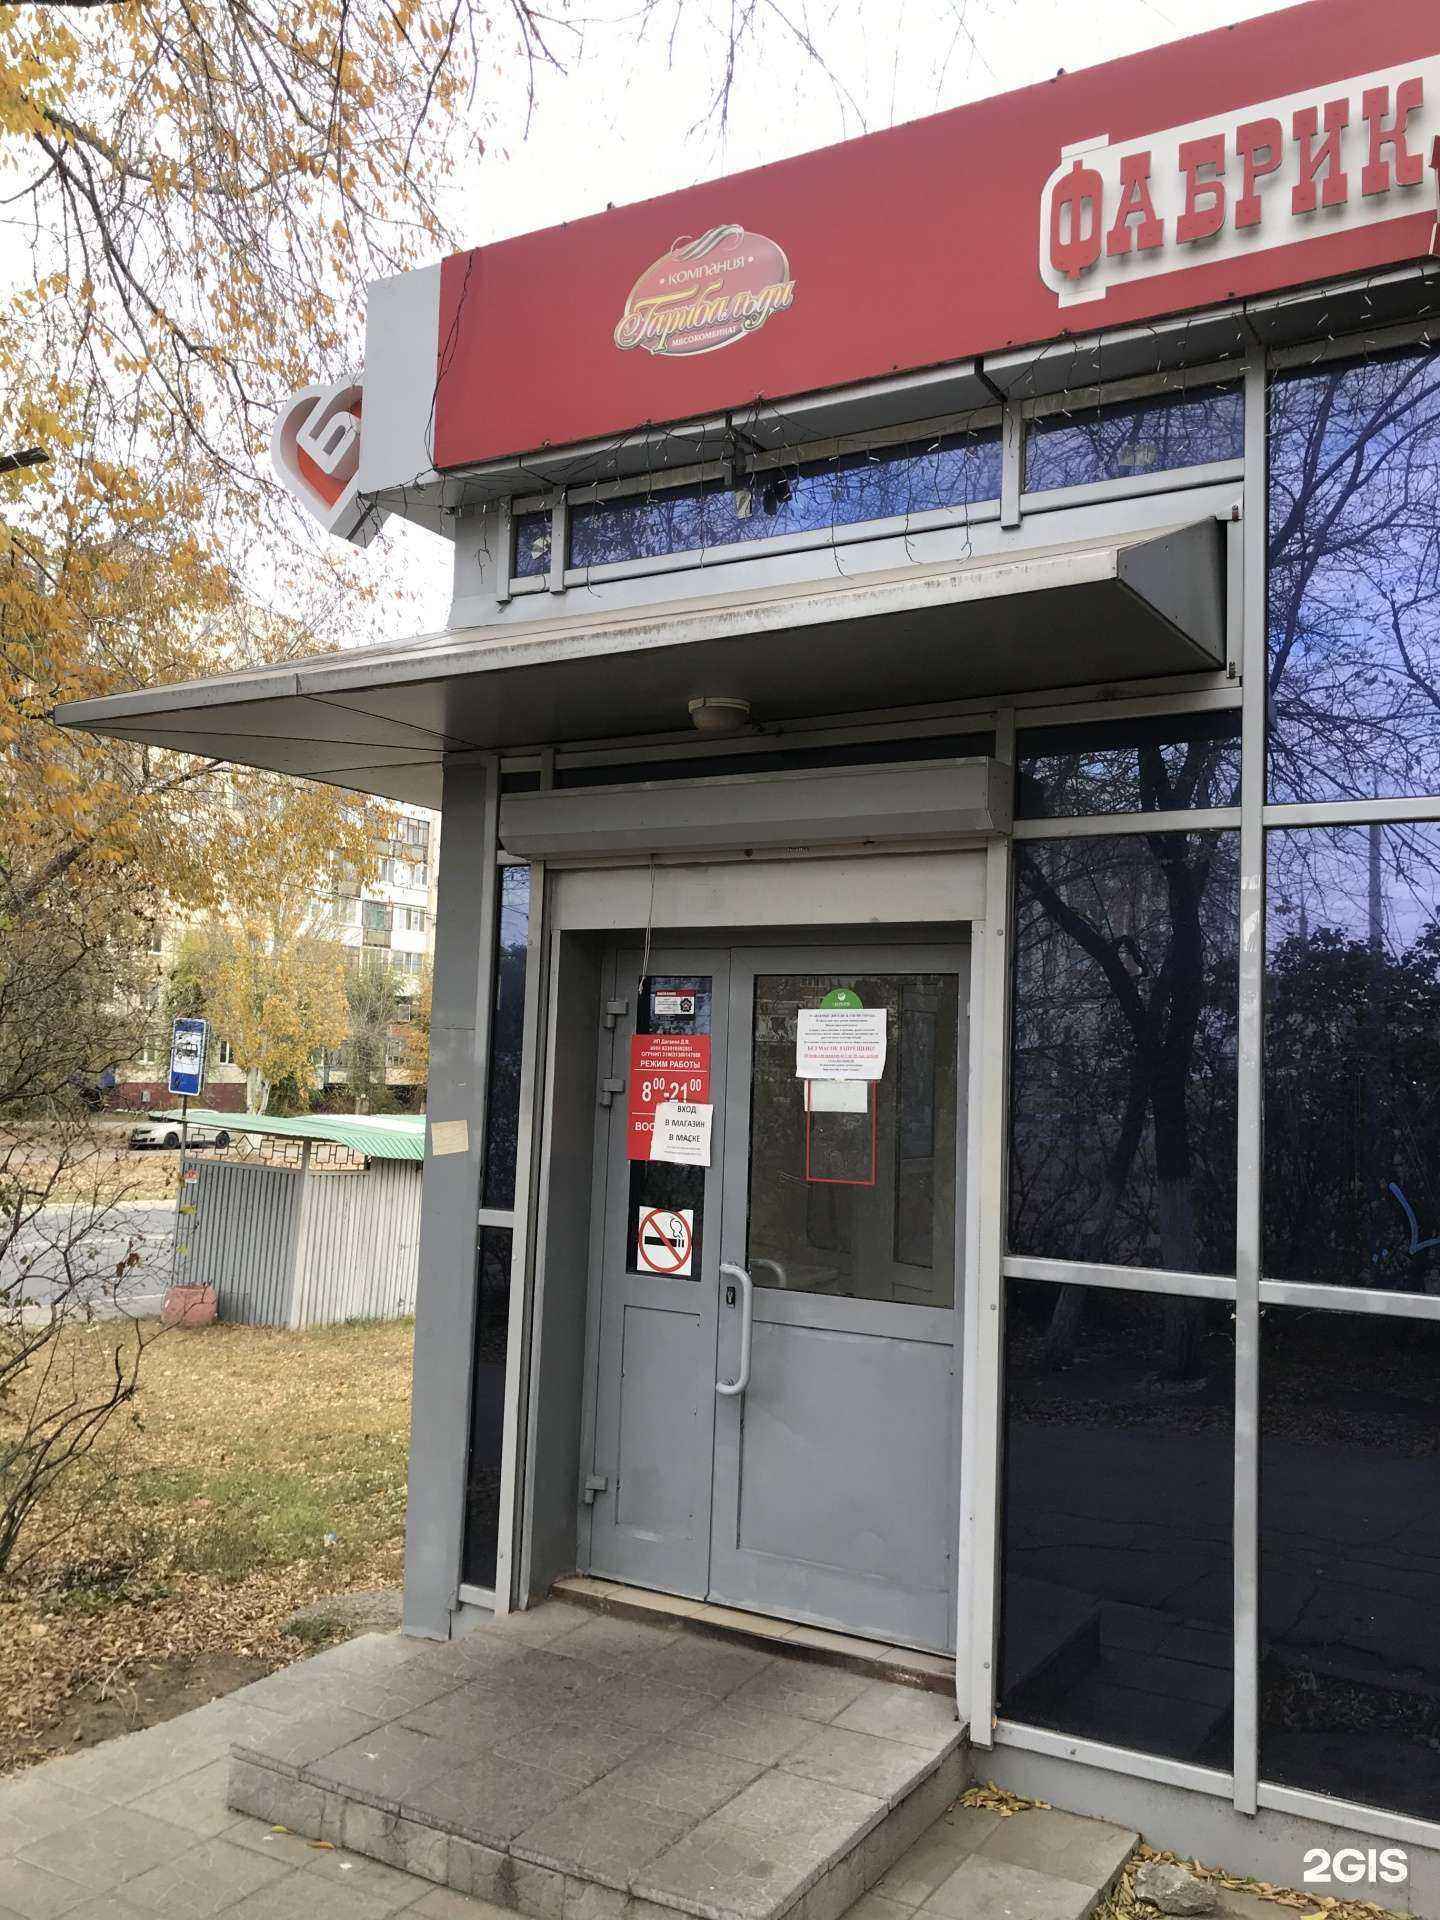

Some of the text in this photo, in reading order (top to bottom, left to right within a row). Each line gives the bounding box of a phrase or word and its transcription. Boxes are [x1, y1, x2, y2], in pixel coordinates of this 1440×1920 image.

[1050, 76, 1440, 280] ФАБРИК
[668, 256, 745, 286] КОМПАНИЯ
[640, 1060, 701, 1069] РЕЖИМ РАБОТЫ
[677, 1105, 697, 1114] ВХОД
[671, 1120, 705, 1128] МАГАЗИН
[669, 1133, 701, 1143] В МАСКЕ
